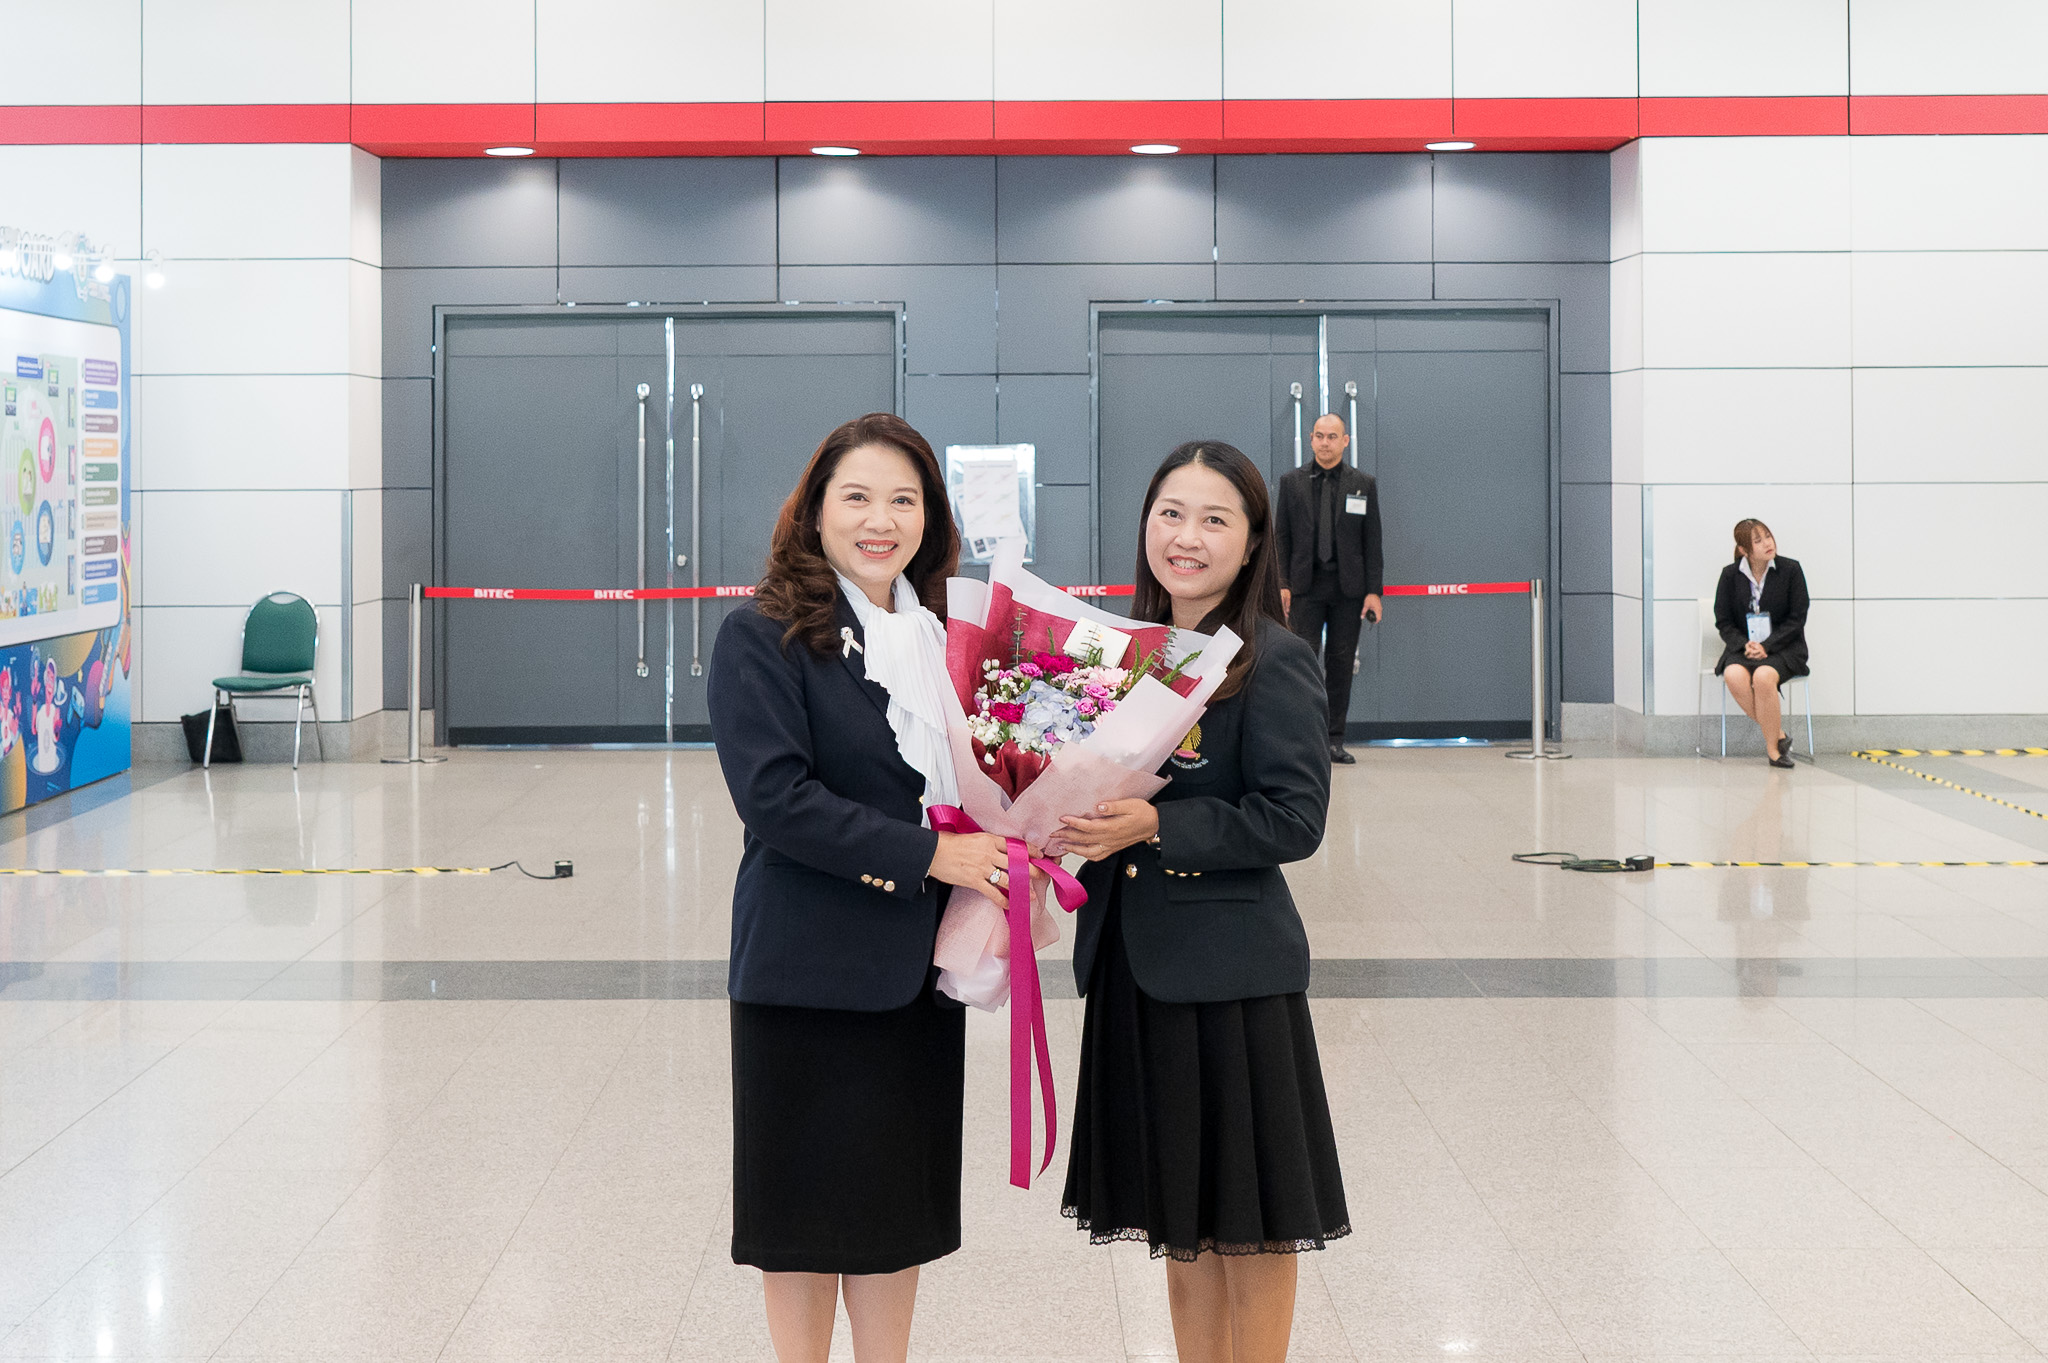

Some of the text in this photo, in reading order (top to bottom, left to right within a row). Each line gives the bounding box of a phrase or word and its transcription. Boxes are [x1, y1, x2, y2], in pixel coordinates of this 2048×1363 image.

[474, 588, 514, 599] BITEC
[594, 589, 634, 600] BITEC
[716, 586, 755, 597] BITEC
[1067, 585, 1107, 596] BITEC
[1428, 584, 1468, 595] BITEC
